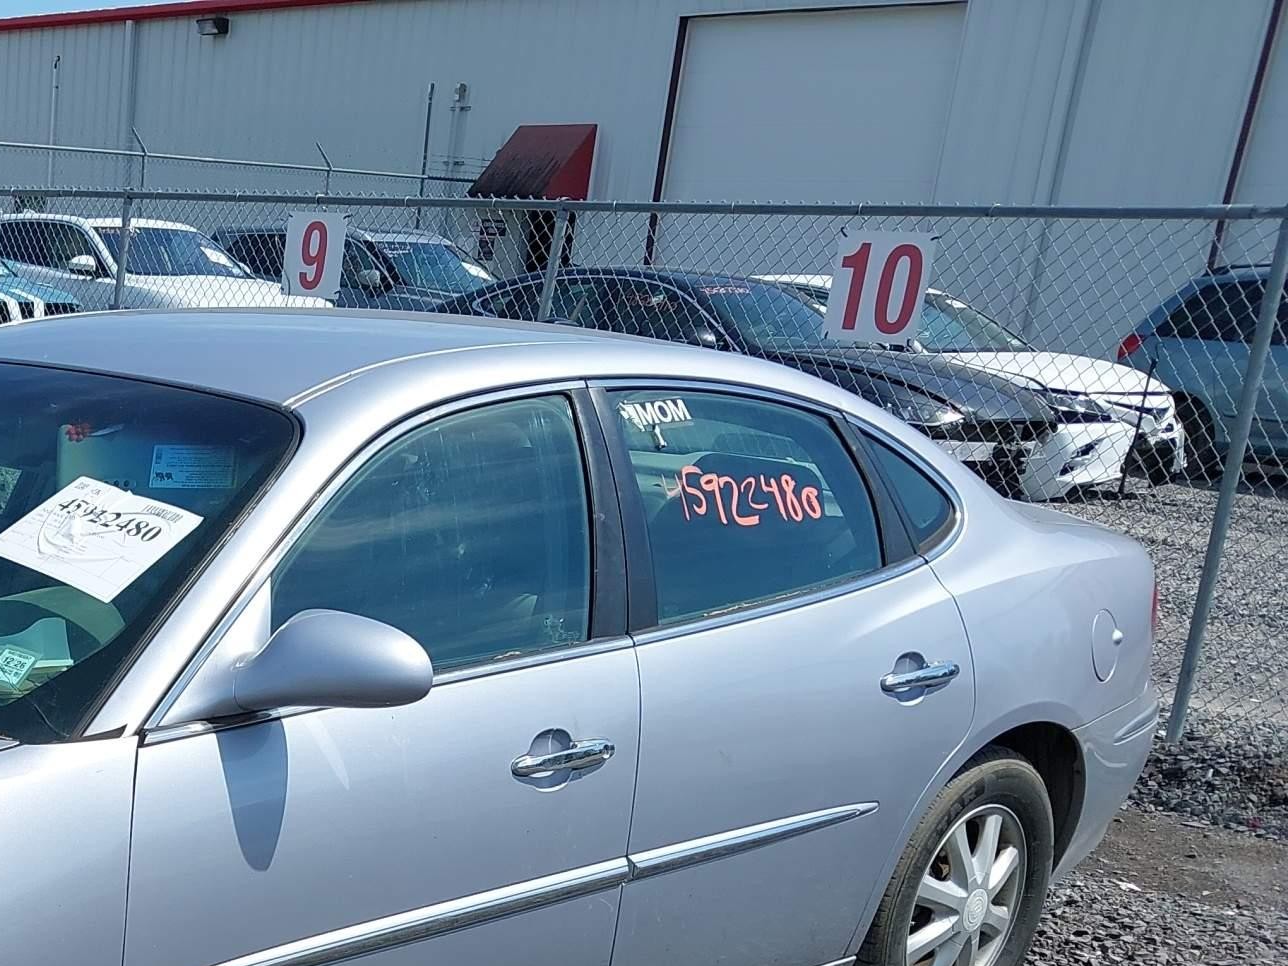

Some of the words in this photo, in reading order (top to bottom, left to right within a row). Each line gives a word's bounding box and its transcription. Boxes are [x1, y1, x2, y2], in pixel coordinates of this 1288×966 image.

[298, 220, 329, 291] 9
[840, 241, 924, 336] 10
[661, 465, 823, 527] 45922480
